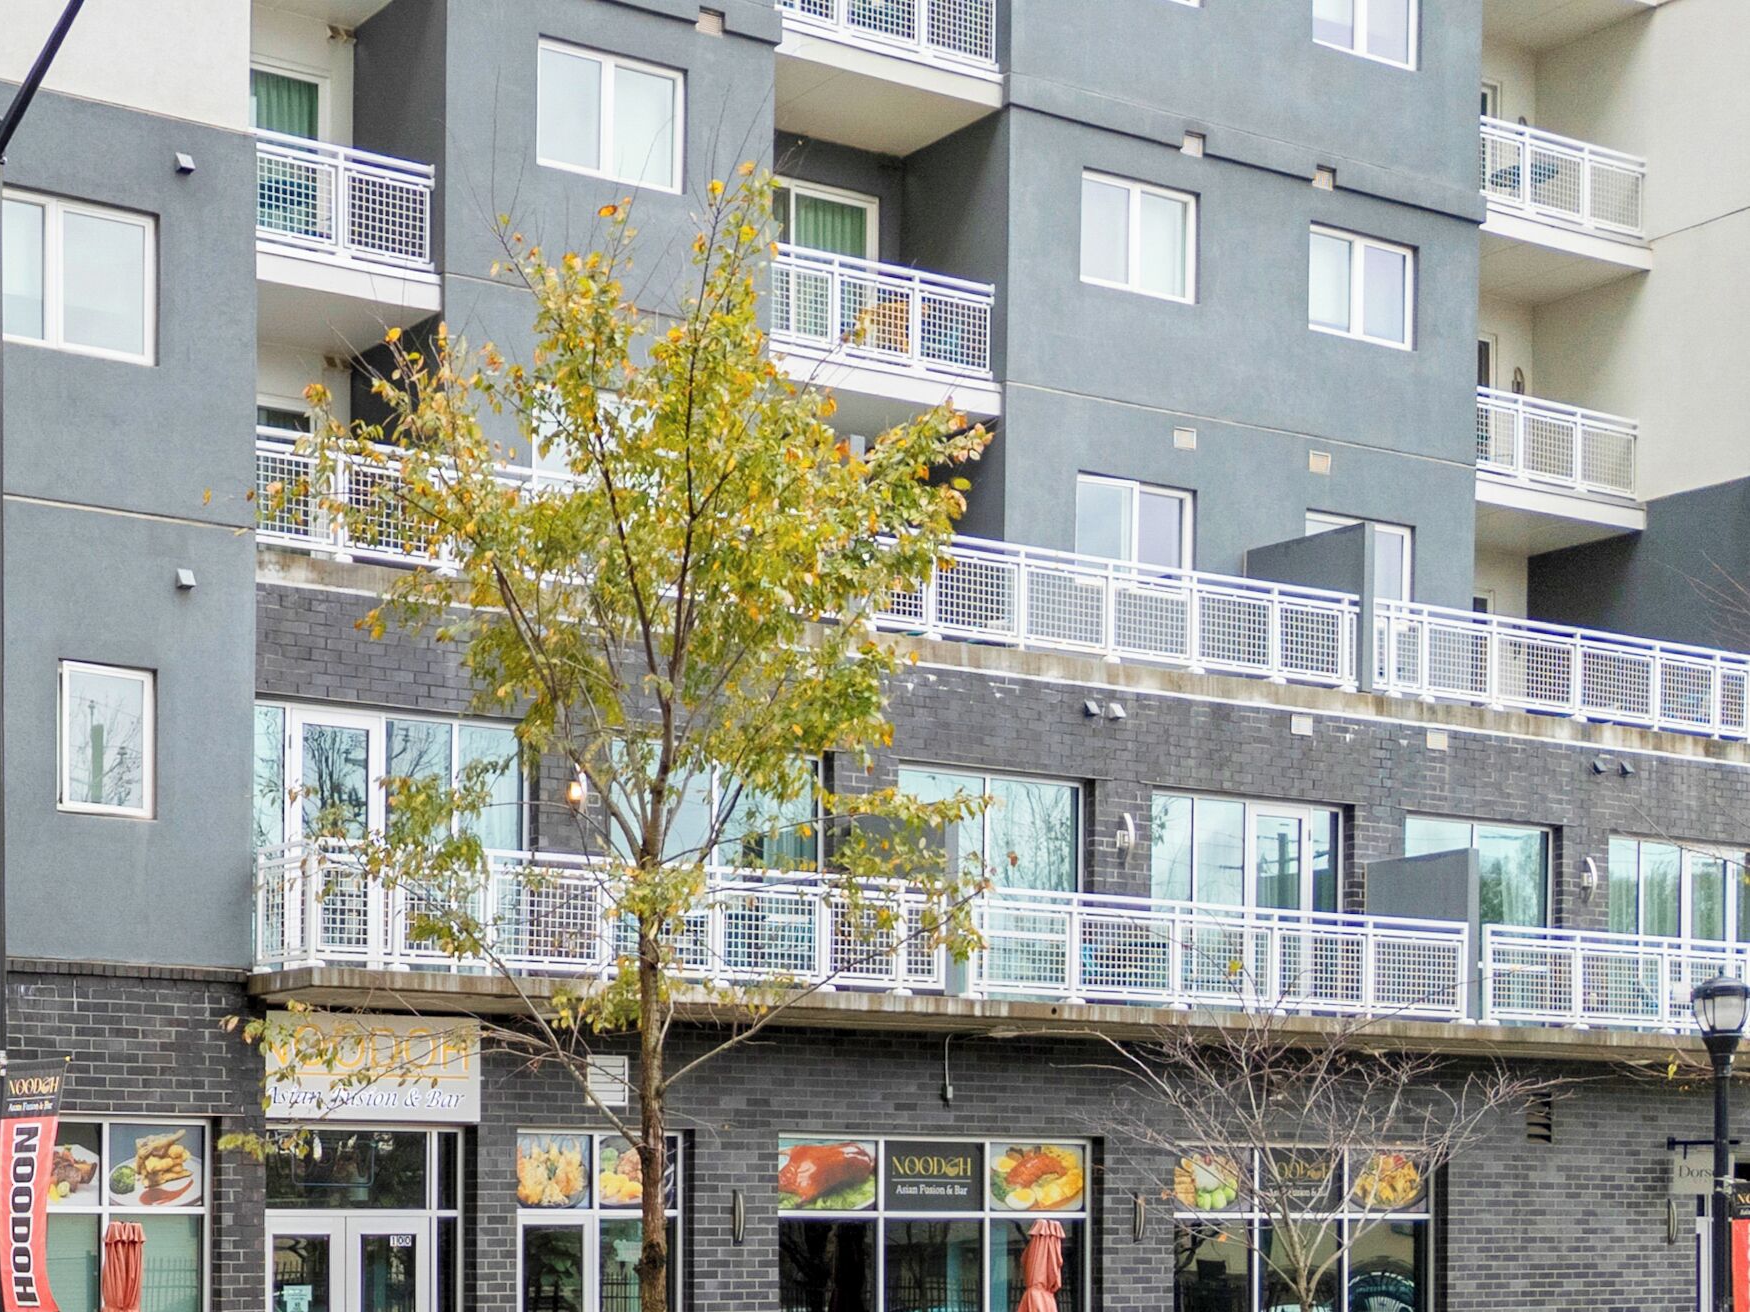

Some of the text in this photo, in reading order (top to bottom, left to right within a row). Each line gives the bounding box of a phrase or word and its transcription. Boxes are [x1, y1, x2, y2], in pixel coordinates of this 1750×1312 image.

[403, 1089, 421, 1108] &
[426, 1087, 465, 1109] Bar
[896, 1184, 918, 1195] Asian
[954, 1185, 968, 1195] Bar
[9, 1122, 42, 1307] NOODOH
[391, 1235, 411, 1246] 100
